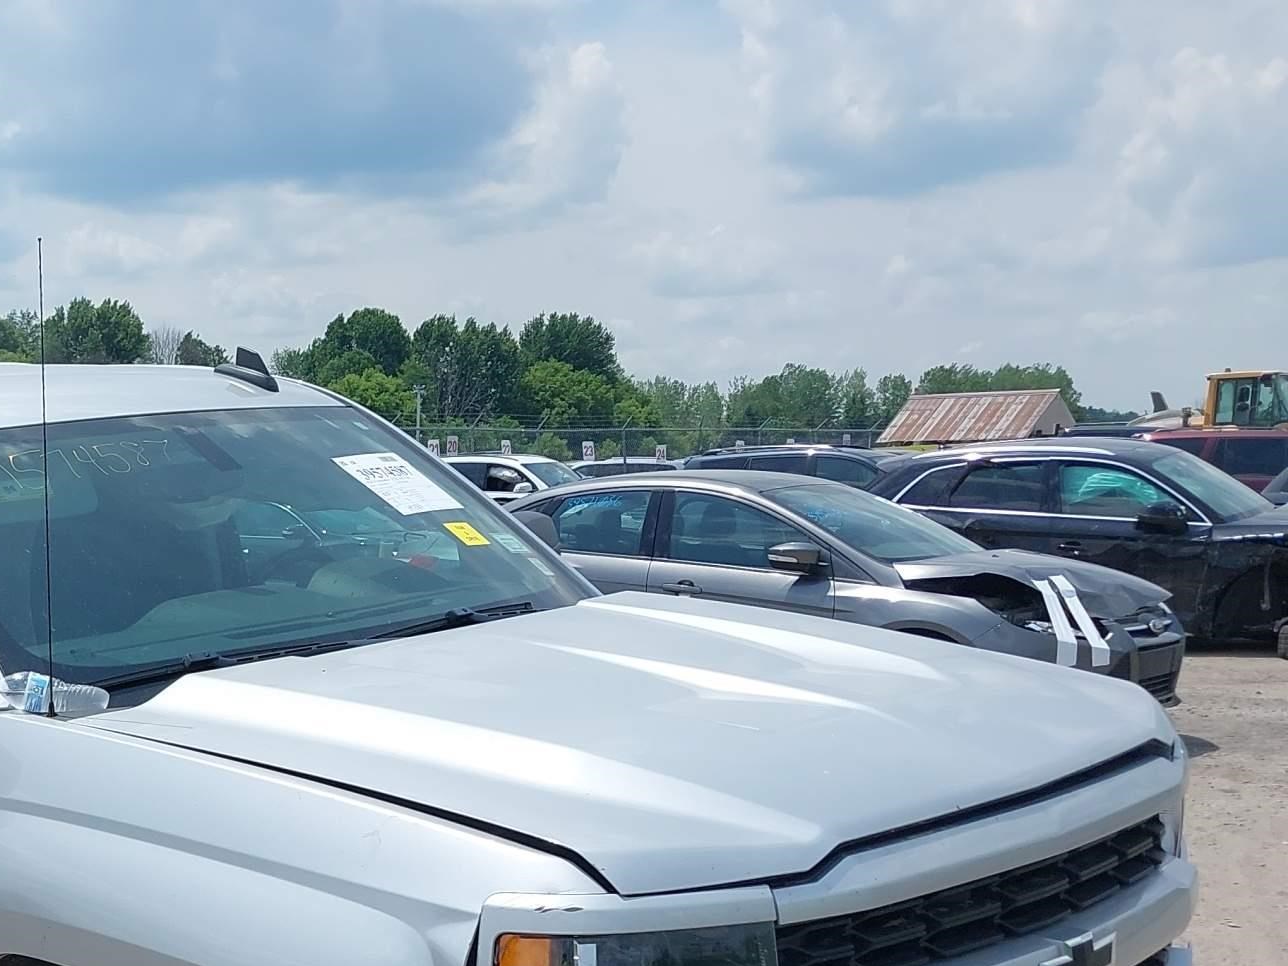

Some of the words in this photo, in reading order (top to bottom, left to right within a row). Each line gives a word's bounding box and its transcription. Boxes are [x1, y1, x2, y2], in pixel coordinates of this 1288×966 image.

[447, 440, 457, 453] 20
[583, 445, 594, 457] 23
[656, 448, 666, 460] 24
